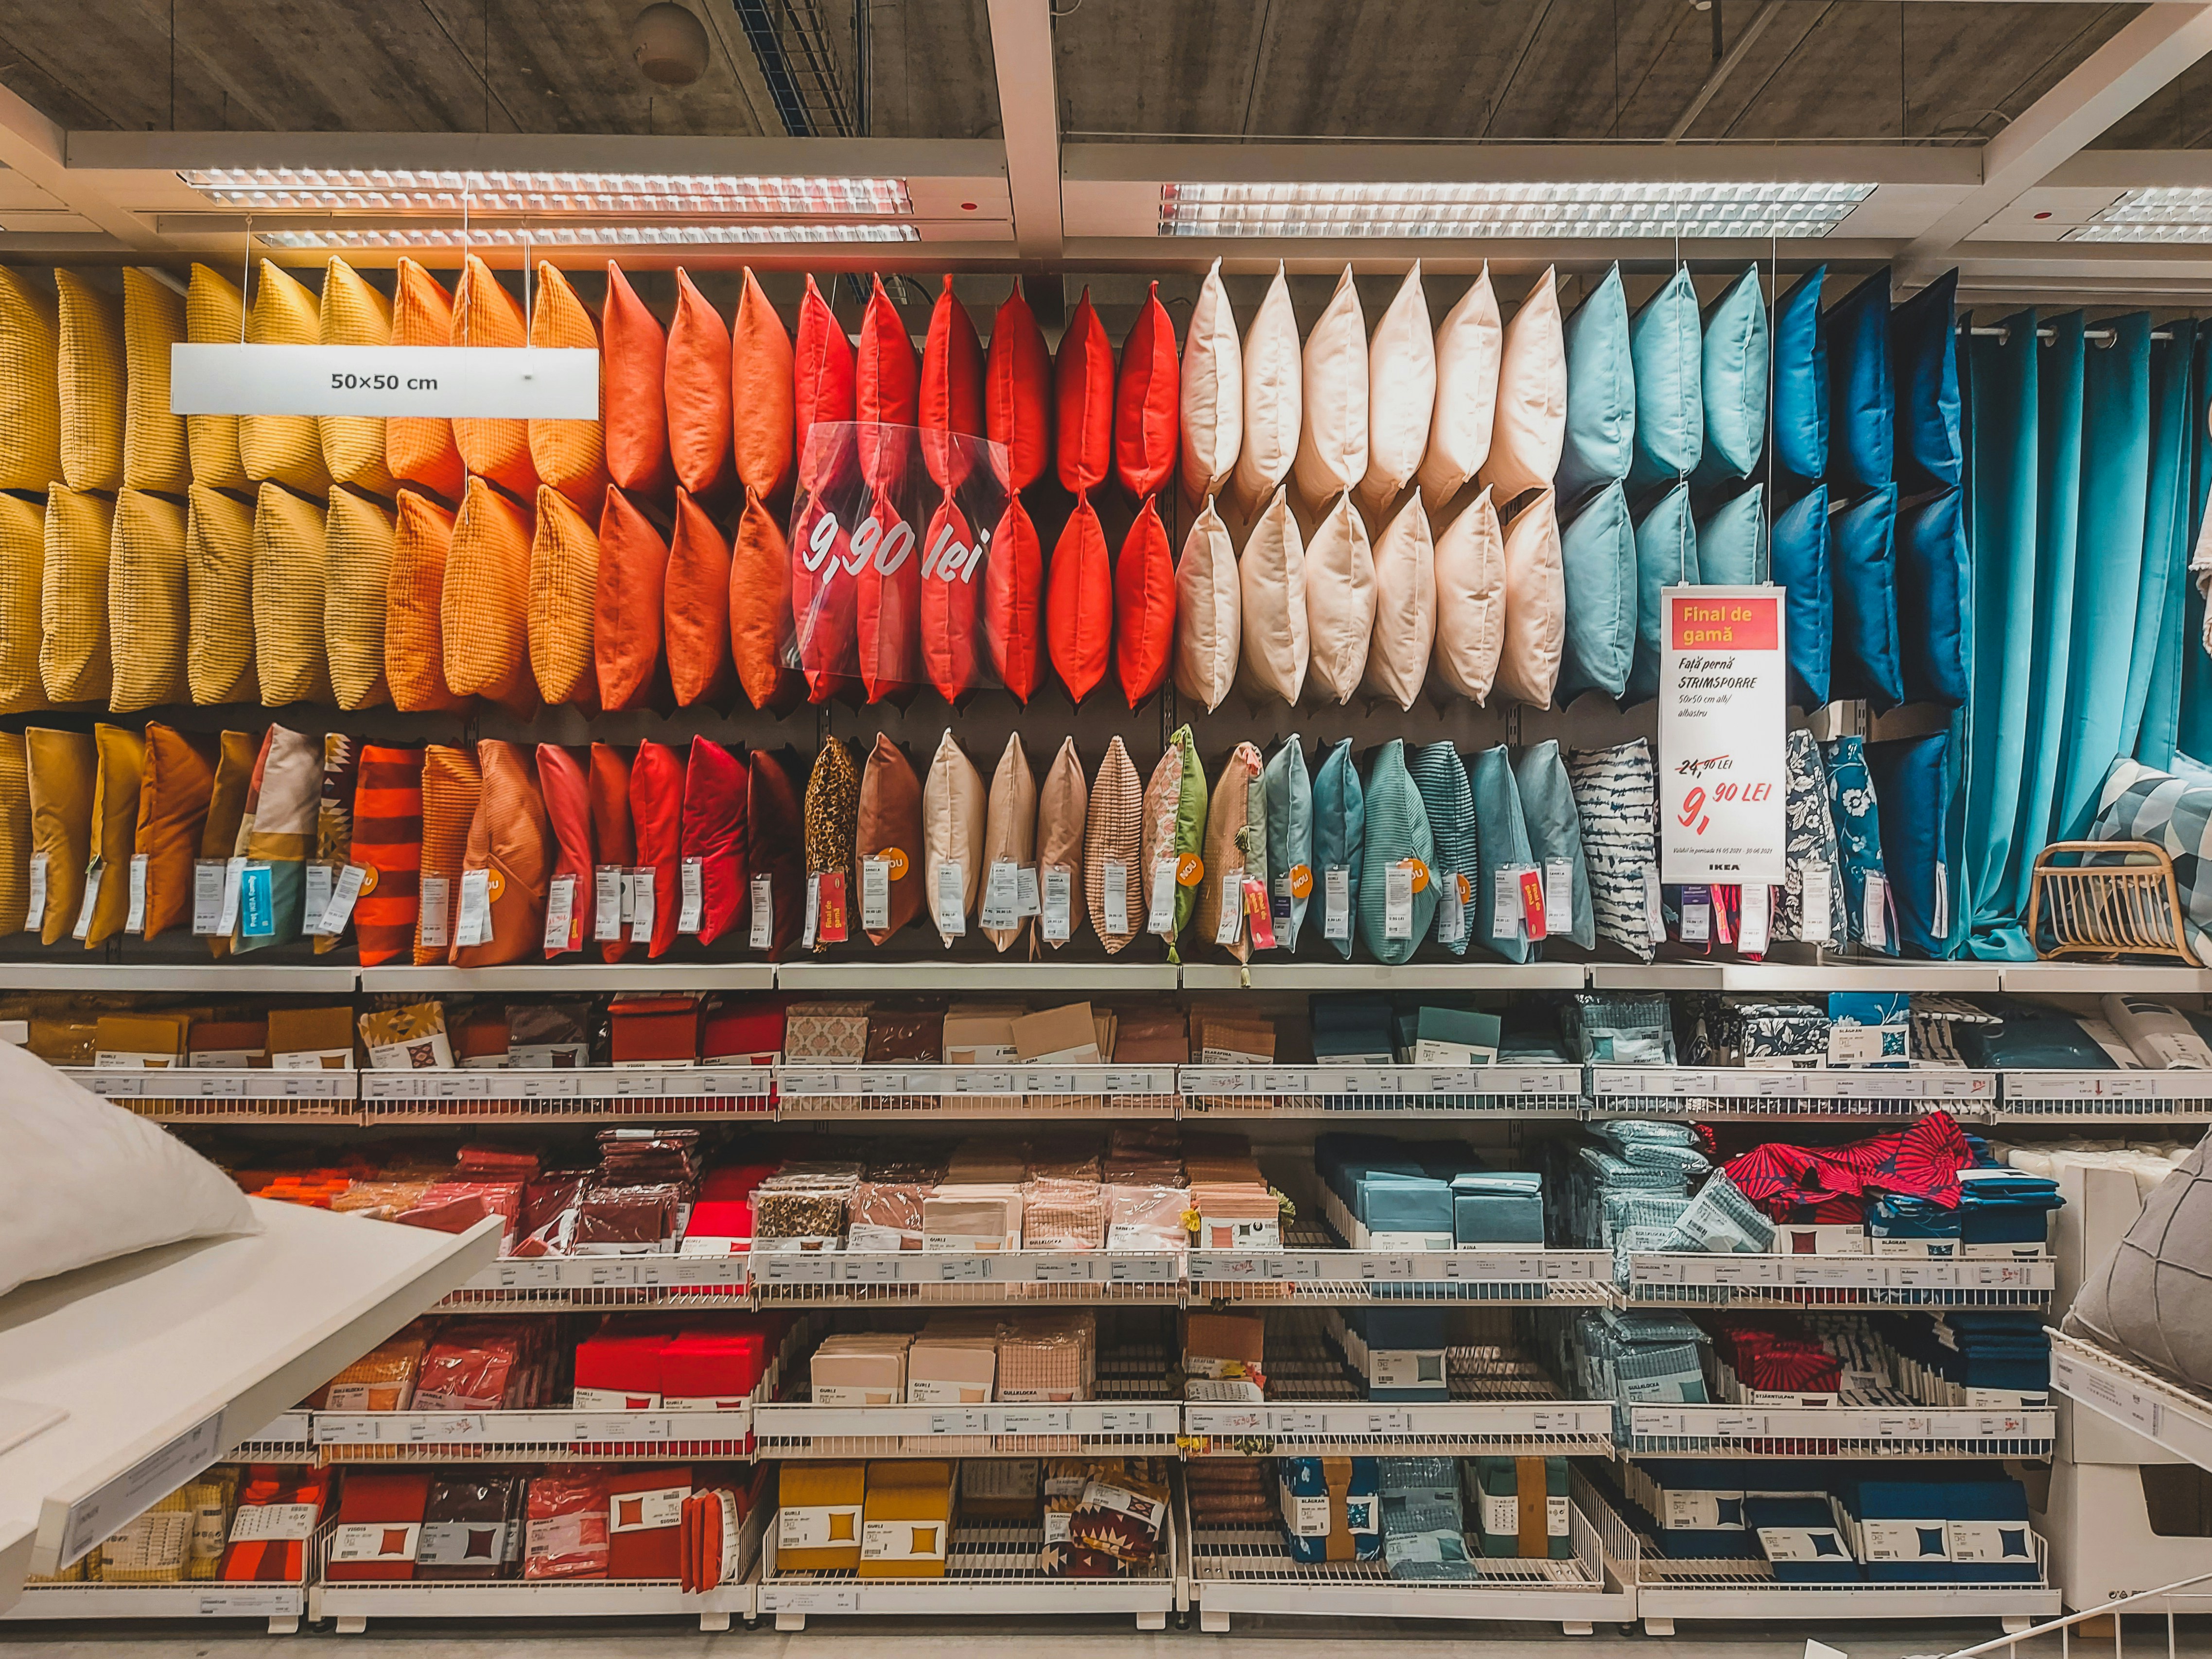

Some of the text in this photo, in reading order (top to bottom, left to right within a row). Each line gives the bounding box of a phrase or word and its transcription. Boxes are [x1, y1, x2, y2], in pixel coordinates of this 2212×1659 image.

[407, 375, 438, 391] cm
[803, 512, 990, 585] 9,90 lei
[1684, 606, 1752, 622] Final de
[1683, 626, 1733, 646] gamă
[1678, 676, 1758, 689] STRIMSPORRE
[1716, 694, 1732, 705] alb/
[1678, 709, 1707, 718] albastru
[1718, 760, 1733, 770] LEI
[1742, 783, 1772, 802] LEI
[889, 859, 903, 868] OU
[1180, 859, 1197, 880] NOU
[1293, 873, 1309, 890] NOU
[826, 900, 832, 910] de
[833, 908, 842, 929] gamă
[1628, 1382, 1659, 1391] GULLKLOCKA
